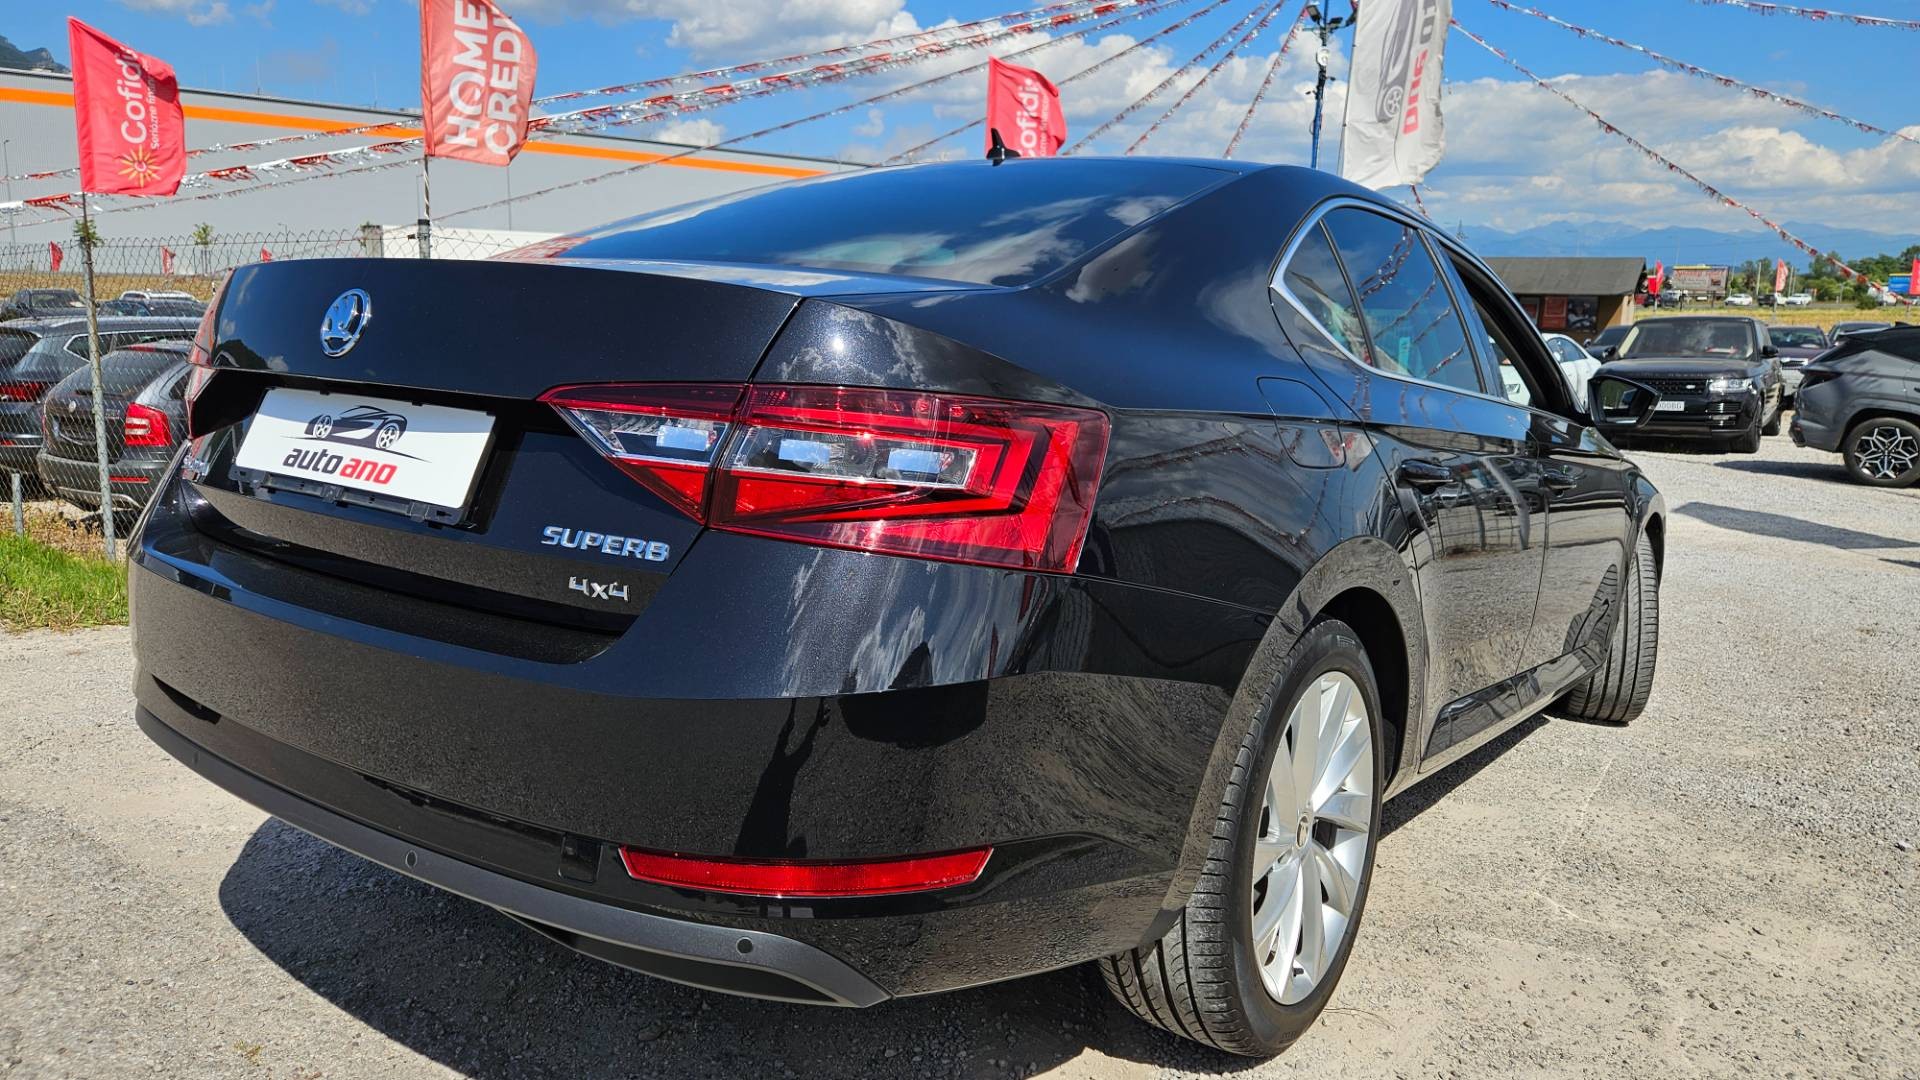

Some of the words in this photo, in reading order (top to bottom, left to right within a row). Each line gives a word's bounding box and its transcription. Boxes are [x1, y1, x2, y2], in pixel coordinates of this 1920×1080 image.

[115, 47, 147, 144] Cofidi
[445, 0, 488, 148] HOME
[485, 8, 523, 155] CREDI
[282, 448, 344, 475] auto
[339, 457, 398, 485] ano
[540, 525, 671, 562] SUPERB
